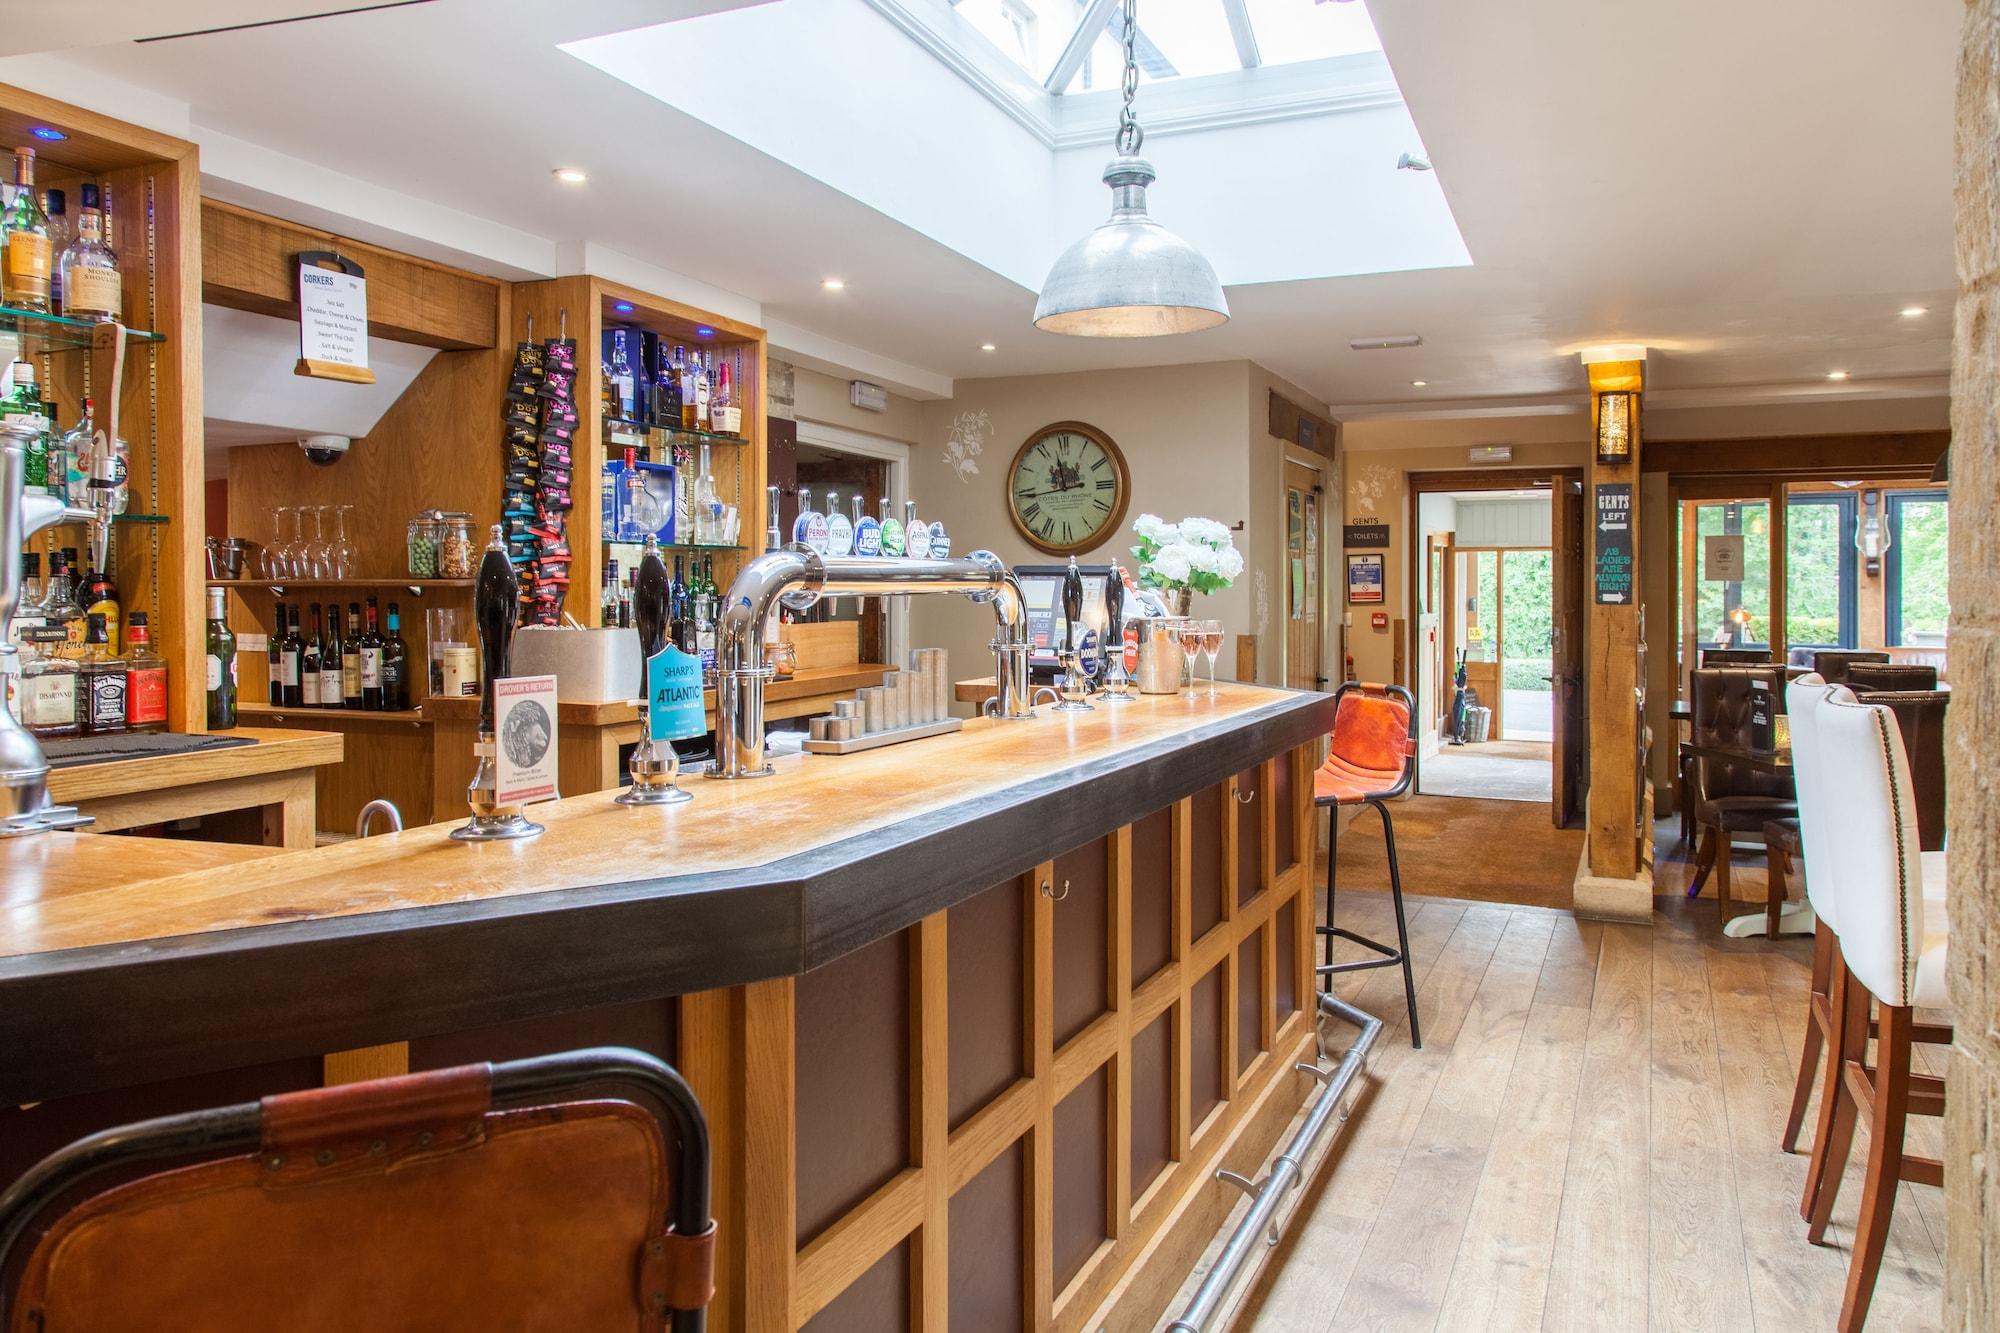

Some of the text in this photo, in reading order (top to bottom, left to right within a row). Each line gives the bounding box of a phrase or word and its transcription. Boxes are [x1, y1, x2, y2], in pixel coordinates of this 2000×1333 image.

[304, 273, 334, 286] CORKERS
[1599, 495, 1630, 509] GENTS
[1352, 517, 1379, 525] GENTS
[1602, 513, 1627, 521] LEFT
[863, 529, 880, 539] BUD
[1353, 532, 1379, 540] TOILETS
[858, 539, 881, 549] LIGHT
[1596, 556, 1631, 564] LADIES
[1602, 565, 1623, 573] ARE
[1595, 574, 1631, 582] ALWAYS
[1599, 583, 1629, 591] RIGHT
[664, 665, 694, 677] SHARP'S
[499, 682, 553, 695] DROVER'S RETURN
[39, 691, 72, 700] DISARONNO
[656, 686, 700, 704] ATLANTIC
